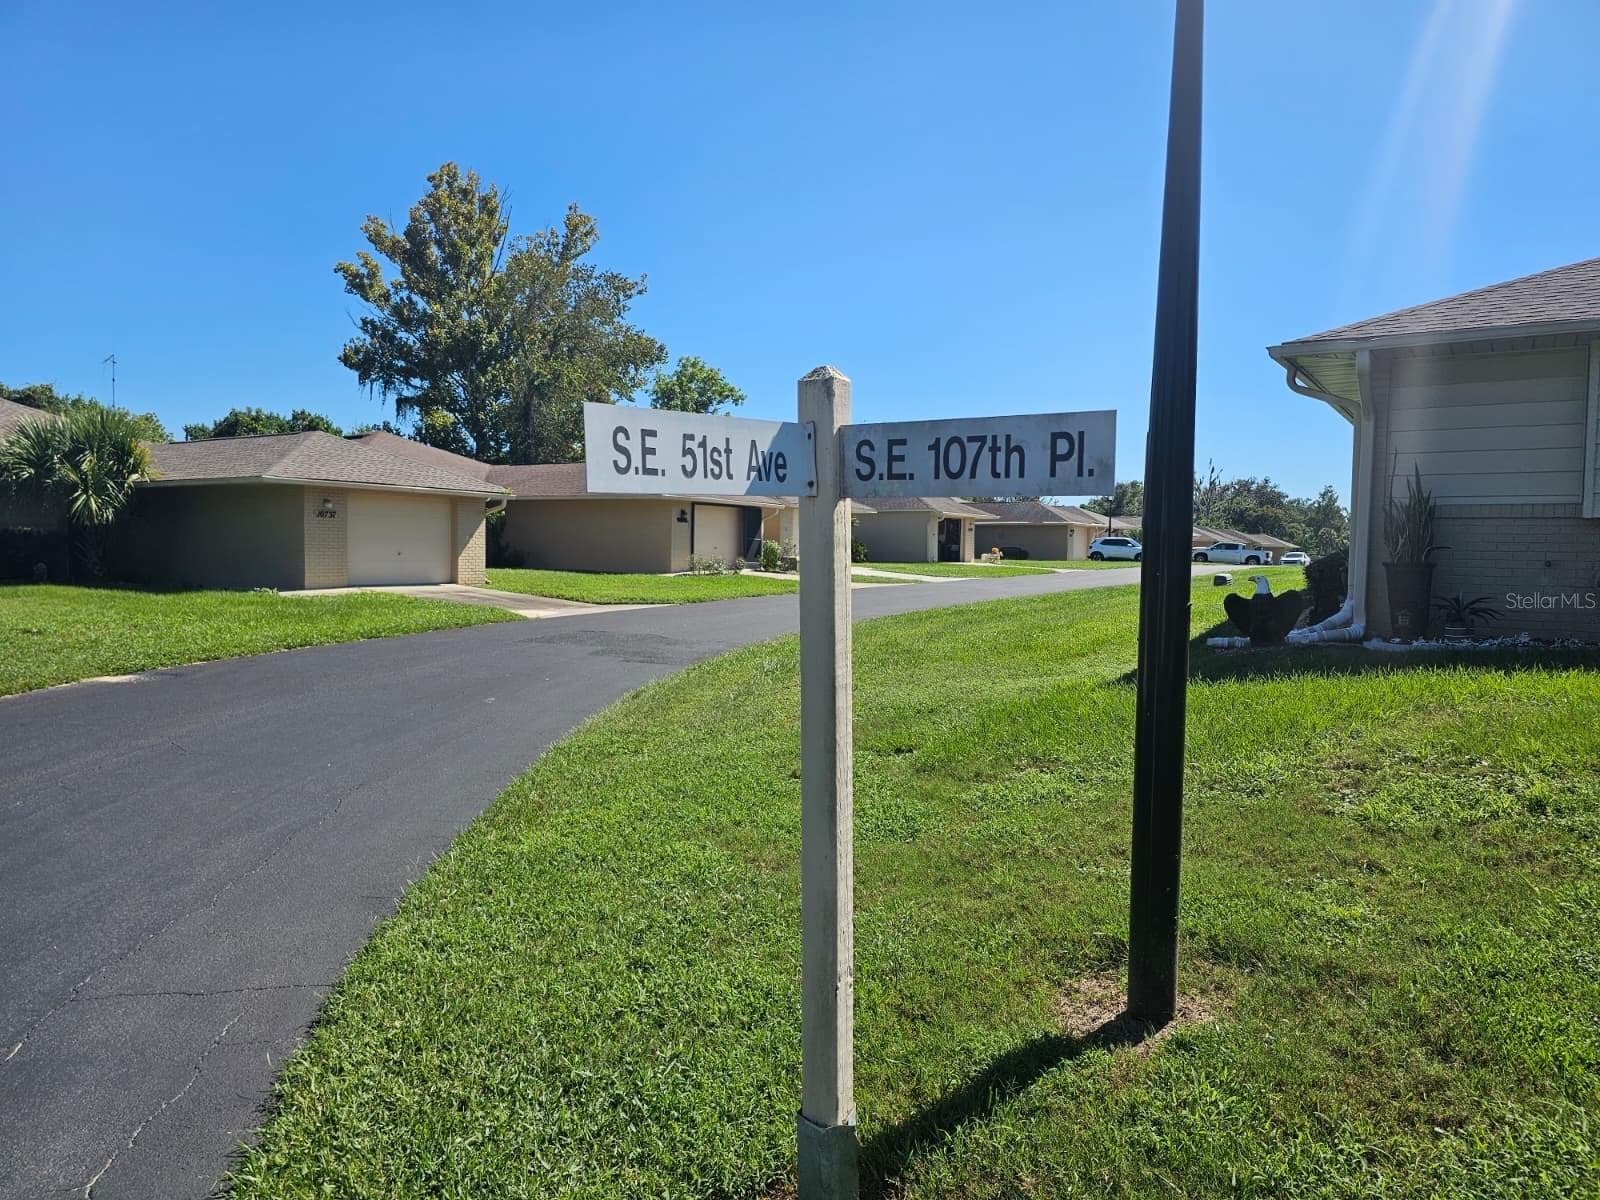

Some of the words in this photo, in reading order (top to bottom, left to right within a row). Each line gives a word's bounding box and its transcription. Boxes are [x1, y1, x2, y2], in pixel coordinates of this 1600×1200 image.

[612, 425, 666, 477] S.E.
[680, 433, 734, 481] 51st
[747, 439, 788, 483] Ave
[855, 438, 915, 481] S.E.
[927, 433, 1026, 480] 107th
[1049, 430, 1095, 478] Pl.
